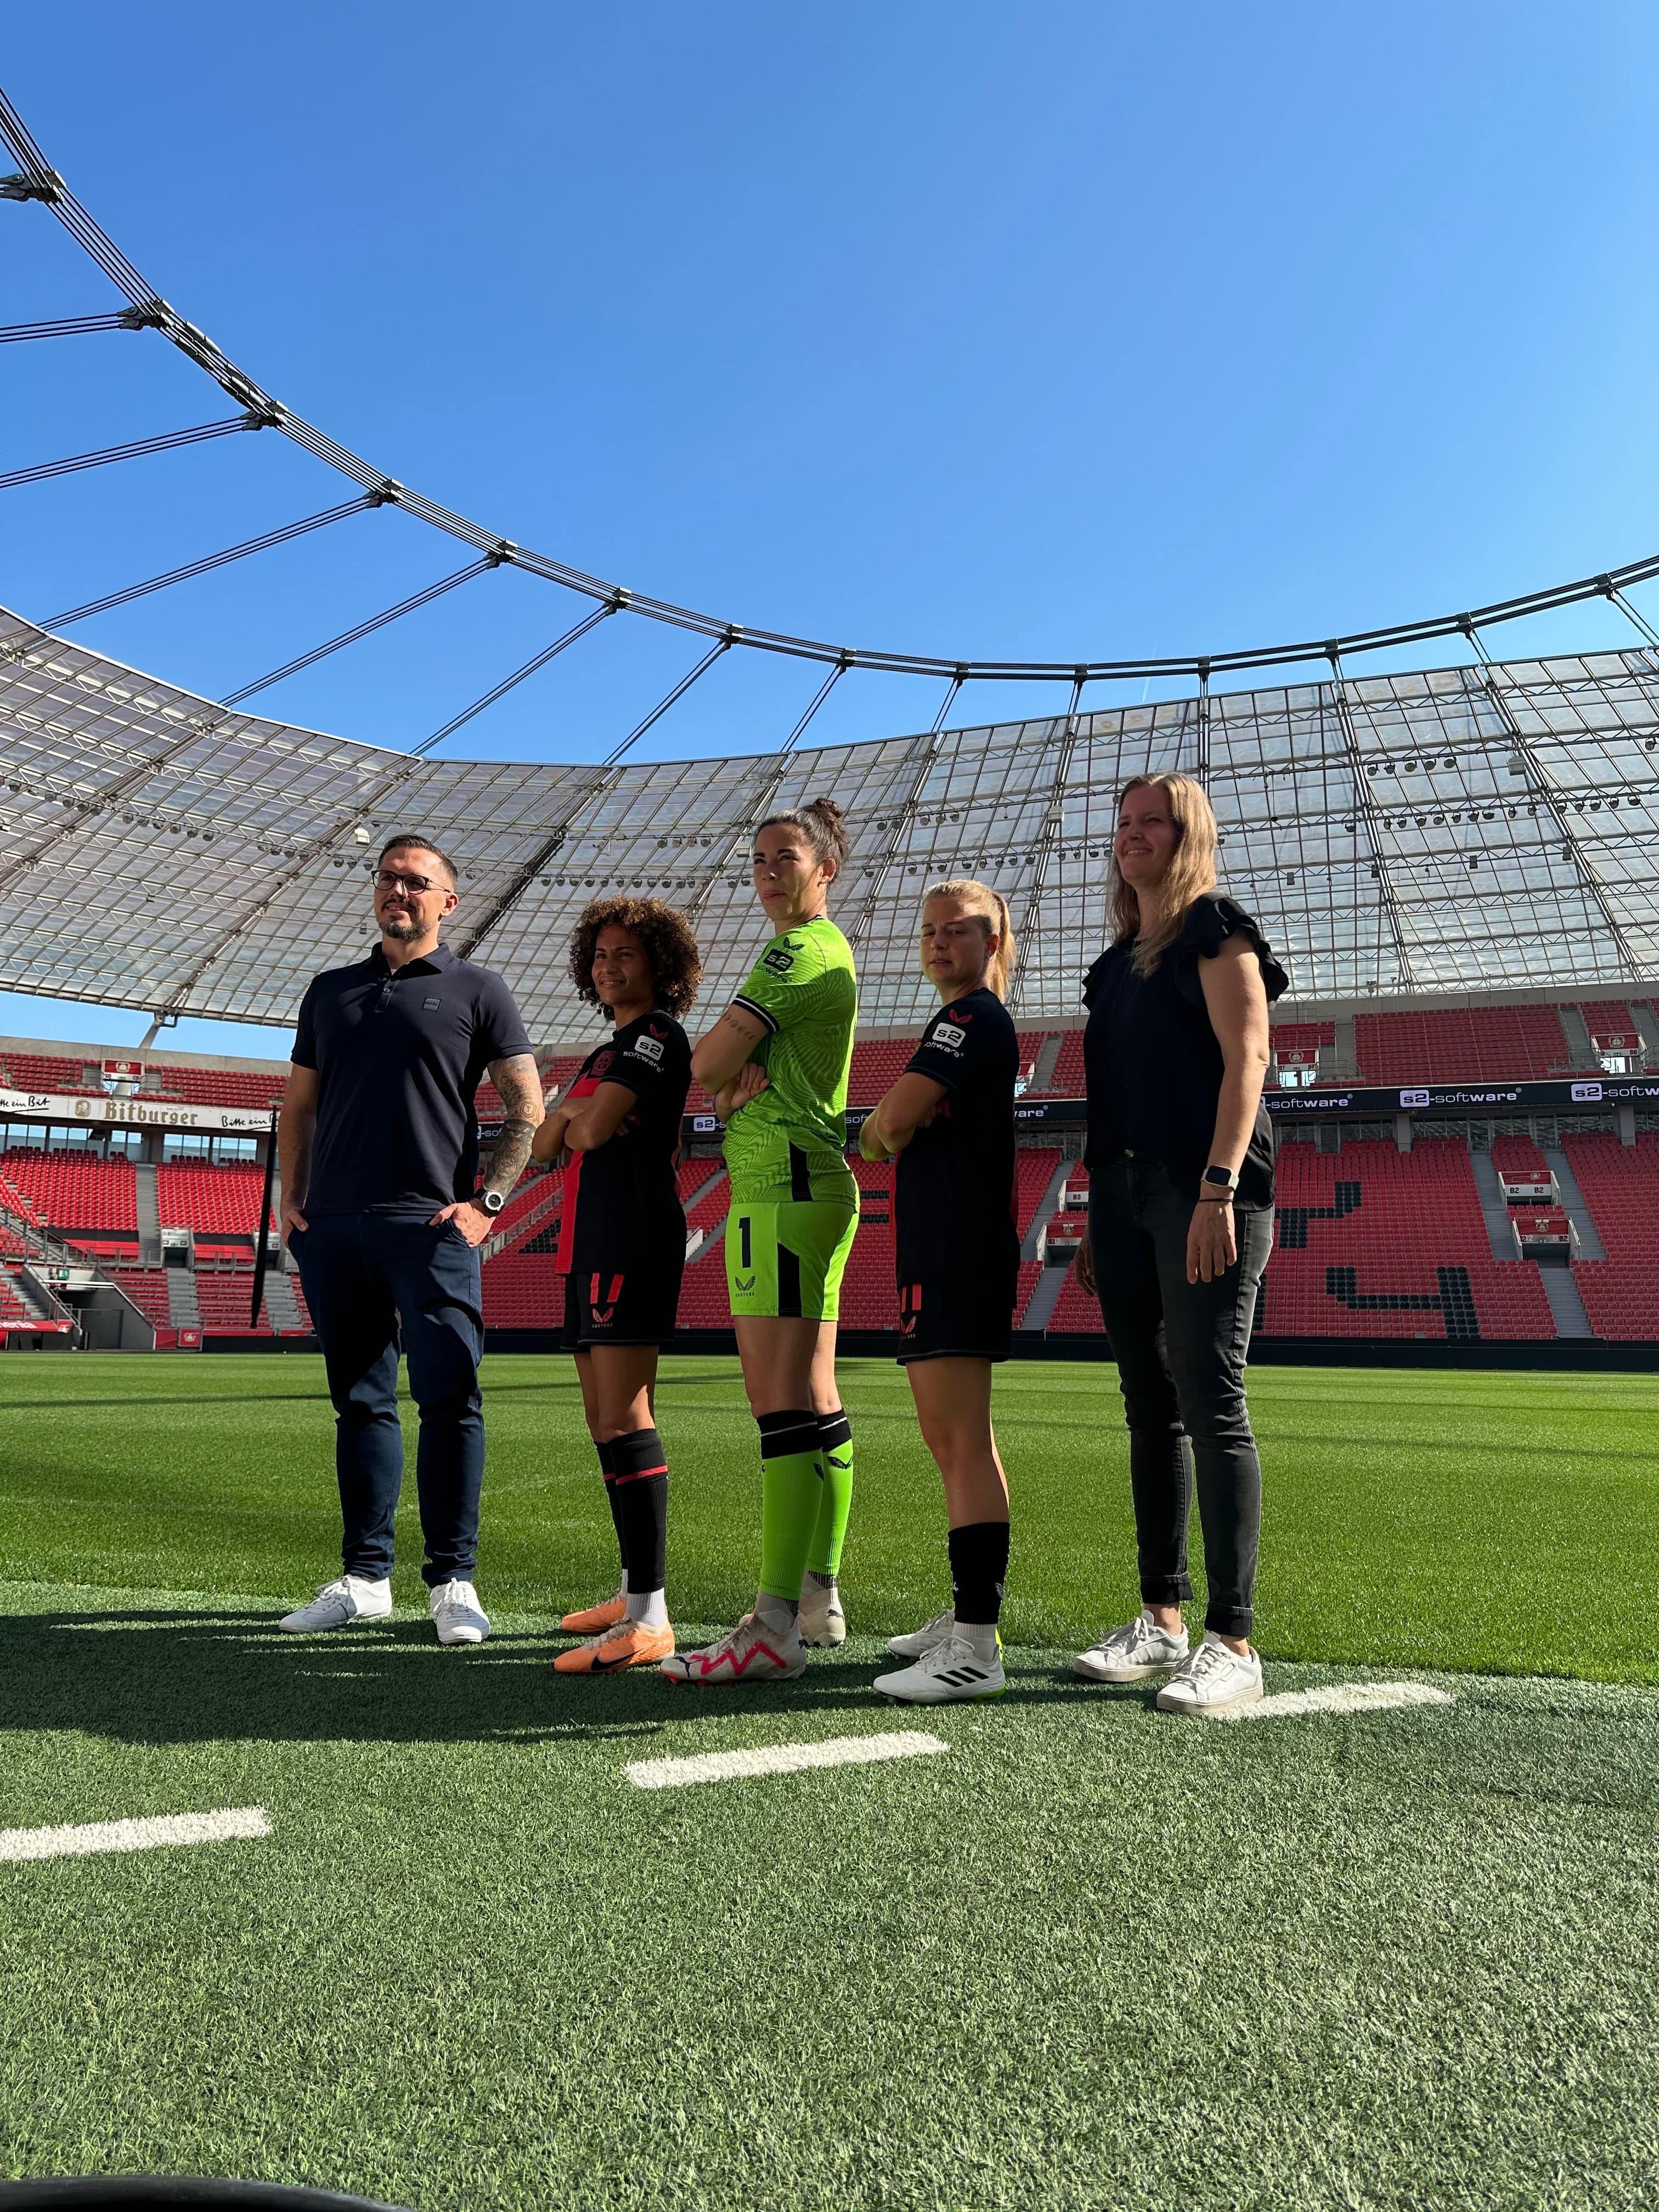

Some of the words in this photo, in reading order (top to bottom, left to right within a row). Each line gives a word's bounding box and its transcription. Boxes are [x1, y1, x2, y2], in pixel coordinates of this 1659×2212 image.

[766, 955, 791, 969] s2
[938, 1029, 962, 1043] s2
[639, 1041, 662, 1057] s2
[28, 1096, 50, 1107] Bit
[104, 1101, 198, 1125] Bitburger
[222, 1115, 246, 1127] Bitte
[738, 1217, 751, 1268] 1
